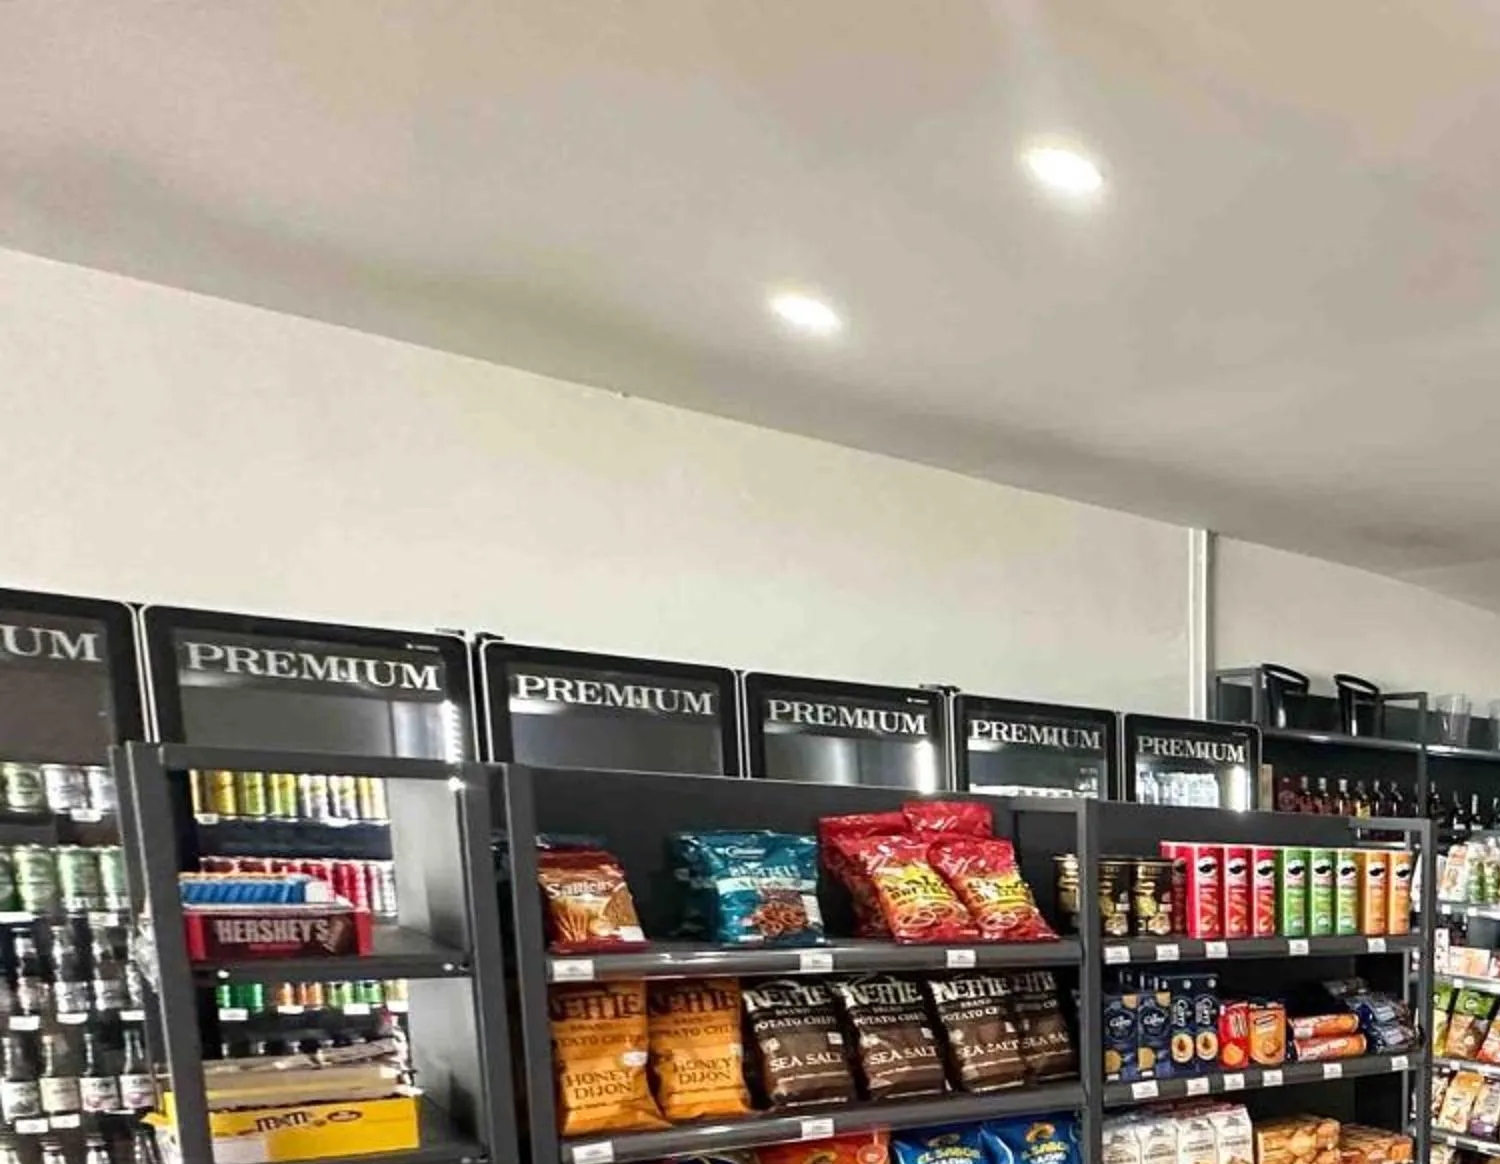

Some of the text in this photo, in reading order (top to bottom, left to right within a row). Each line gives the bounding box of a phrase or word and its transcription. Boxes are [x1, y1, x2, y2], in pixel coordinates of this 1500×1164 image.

[185, 642, 441, 692] PREMIUM
[516, 673, 715, 715] PREMIUM
[768, 699, 928, 735] PREMIUM
[970, 719, 1101, 750] PREMIUM
[1137, 735, 1246, 762] PREMIUM
[673, 1056, 732, 1074] HONEY
[769, 1051, 841, 1073] SEA SALT
[869, 1045, 936, 1065] SEA SALT
[566, 1071, 632, 1088] HONEY
[679, 1070, 731, 1086] DIJON
[574, 1083, 632, 1101] DIJON
